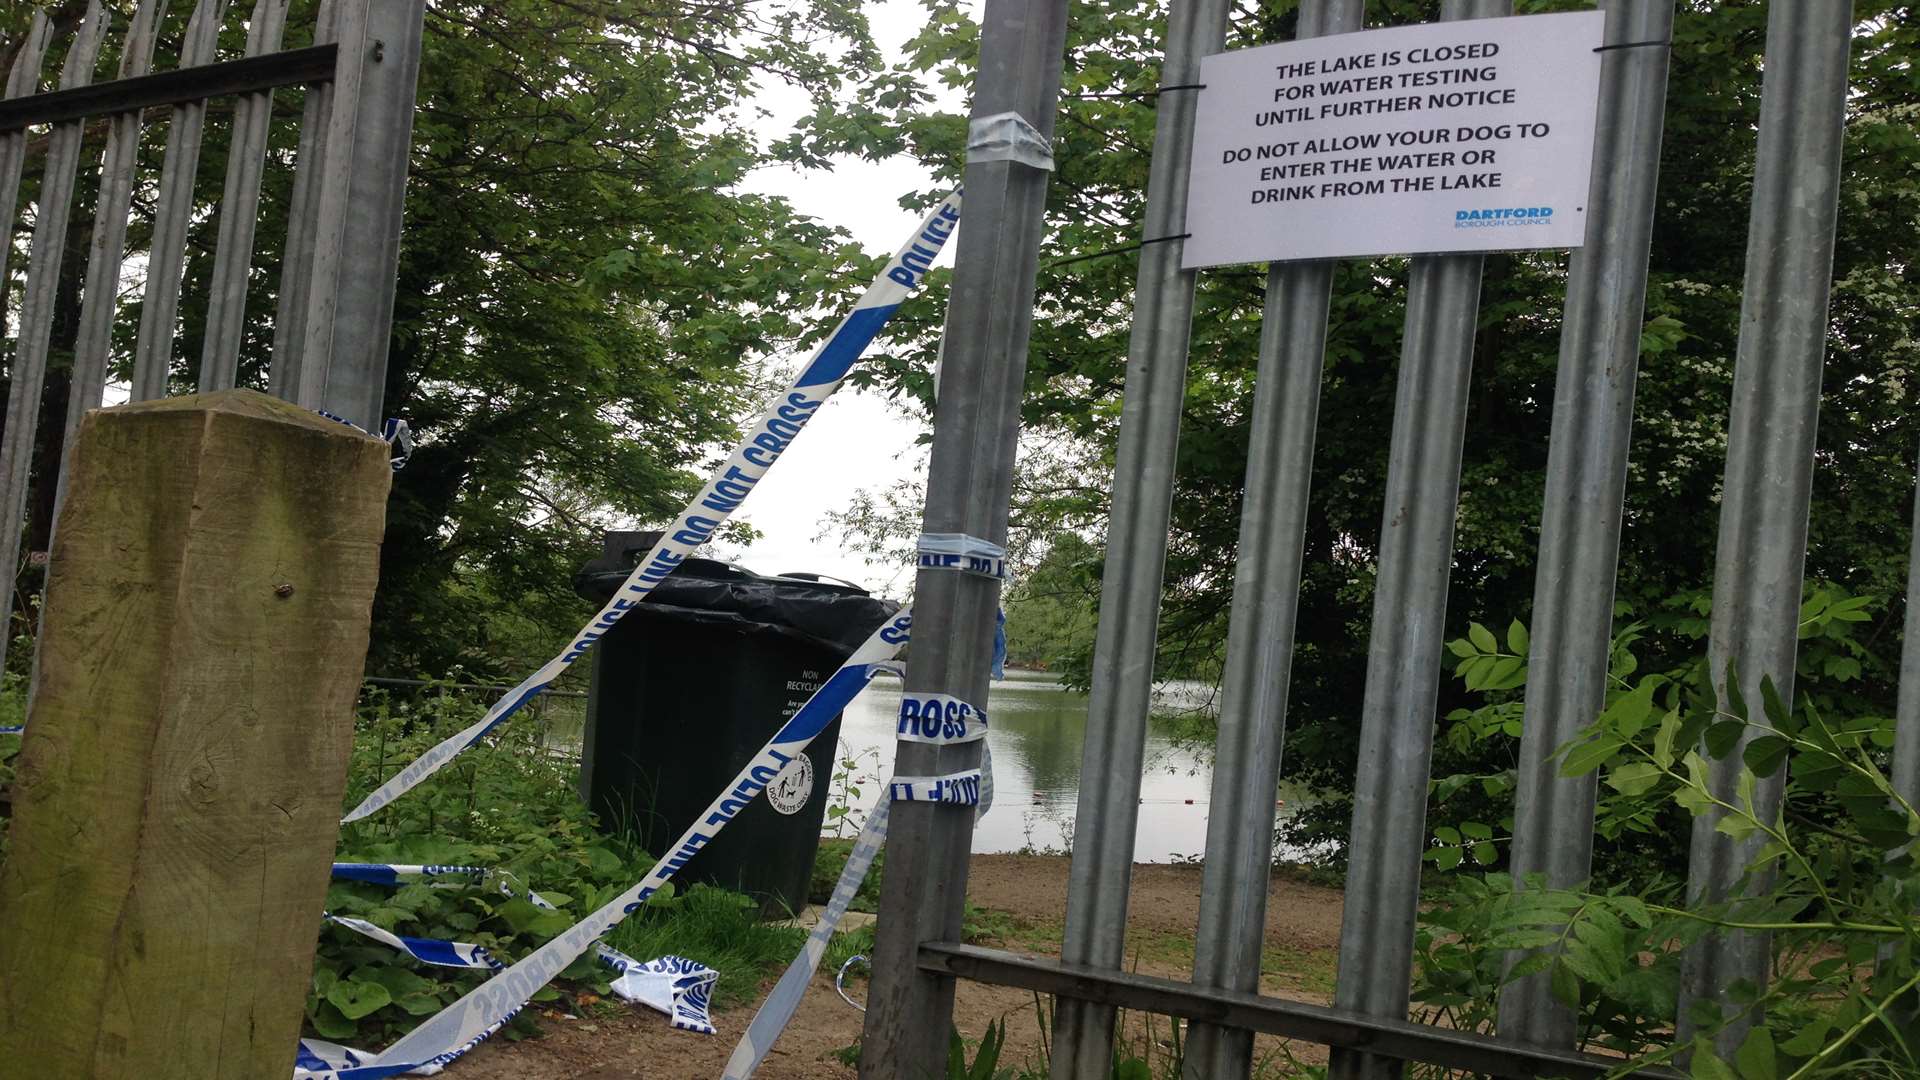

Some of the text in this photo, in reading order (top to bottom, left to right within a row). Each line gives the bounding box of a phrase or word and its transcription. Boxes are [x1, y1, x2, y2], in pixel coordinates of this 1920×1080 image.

[1276, 42, 1500, 79] THE LAKE IS CLOSED
[1274, 66, 1497, 102] FOR WATER TESTING
[1255, 89, 1516, 127] UNTIL FURTHER NOTICE
[1223, 122, 1550, 164] DO NOT ALLOW YOUR DOG TO
[1260, 149, 1496, 181] ENTER THE WATER OR
[1251, 172, 1502, 204] DRINK FROM THE LAKE
[1455, 207, 1553, 221] DARTFORD
[1455, 217, 1552, 229] BOROUGH COUNCIL
[888, 203, 960, 288] POLICE
[561, 392, 823, 663] POLICE LINE DO NOT CROSS
[802, 669, 819, 680] NON
[898, 698, 970, 740] ROSS
[768, 787, 780, 805] DOG
[776, 800, 797, 813] WASTE
